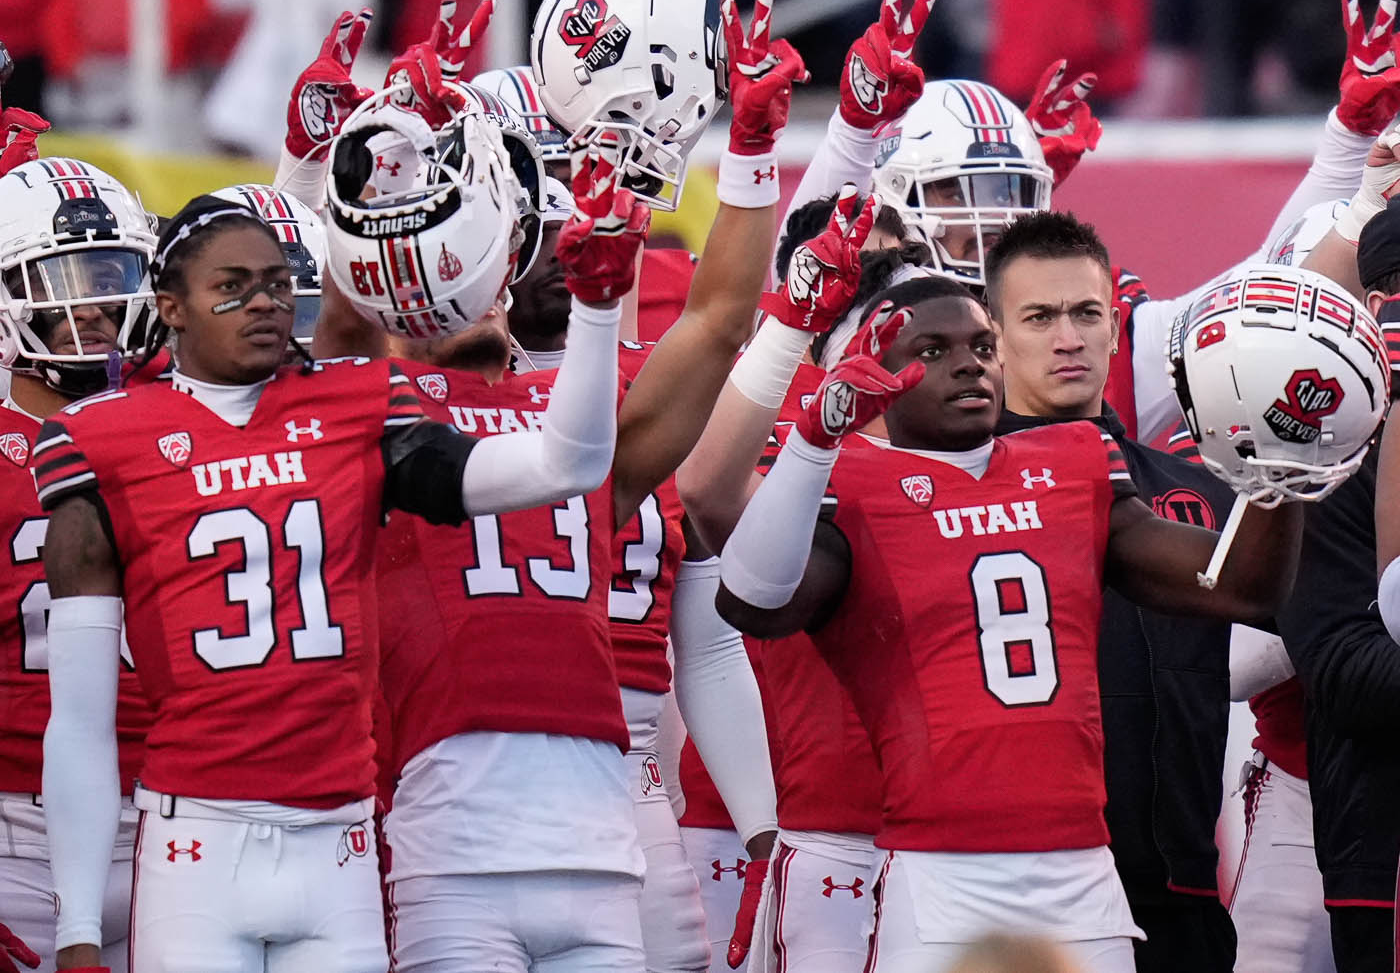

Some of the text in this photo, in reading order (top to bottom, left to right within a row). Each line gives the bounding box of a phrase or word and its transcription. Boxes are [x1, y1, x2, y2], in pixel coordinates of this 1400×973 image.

[565, 2, 599, 36] TJAL
[584, 22, 631, 71] FOREVER
[1297, 380, 1332, 412] TJAL
[448, 406, 546, 435] UTAH
[1264, 408, 1319, 441] FOREVER
[158, 432, 191, 459] PAC
[169, 447, 188, 463] 12
[192, 451, 307, 497] UTAH
[901, 476, 933, 496] PAC
[912, 489, 929, 503] 12
[933, 501, 1043, 539] UTAH
[464, 495, 592, 601] 13
[187, 499, 345, 673] 31
[968, 550, 1061, 709] 8
[647, 762, 661, 784] U
[350, 830, 367, 853] U
